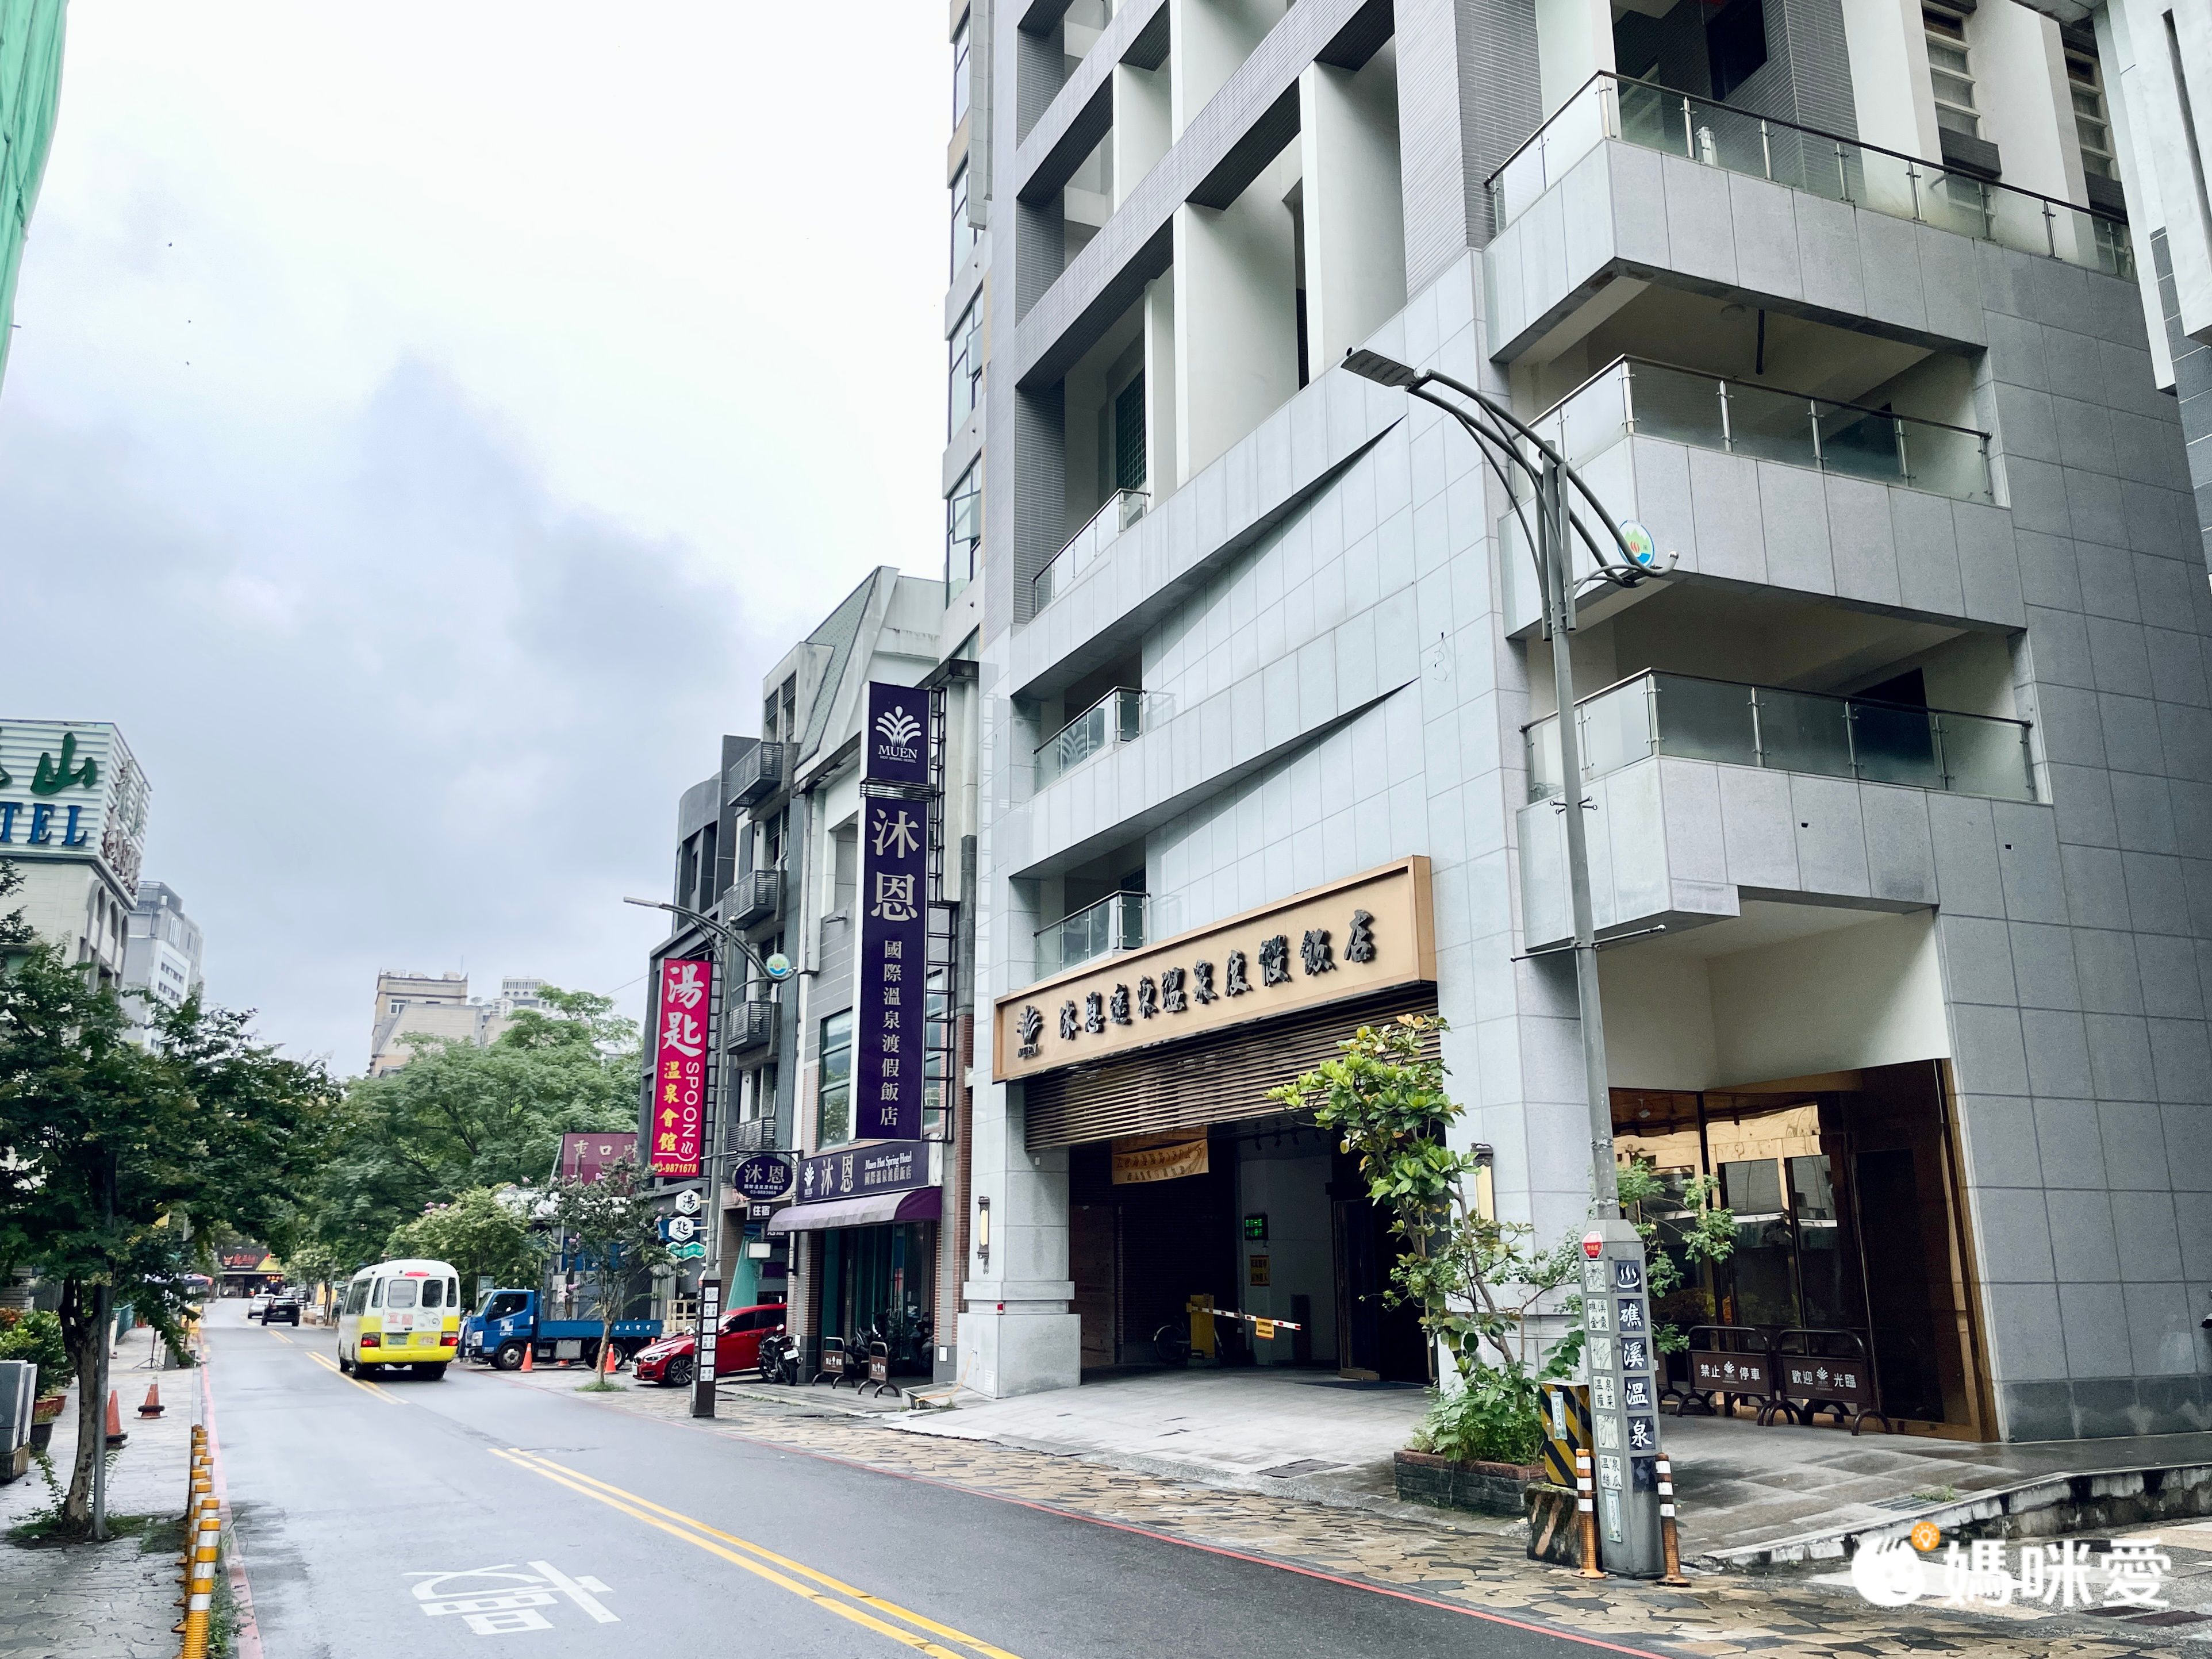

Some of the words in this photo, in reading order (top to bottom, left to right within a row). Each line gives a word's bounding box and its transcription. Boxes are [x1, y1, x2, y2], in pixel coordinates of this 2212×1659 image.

[877, 744, 918, 759] MUEN
[870, 809, 920, 922] 沐恩
[662, 963, 704, 1057] 湯匙
[880, 940, 903, 1127] 國際溫泉渡假飯店
[682, 1061, 700, 1138] SPOON
[877, 1157, 885, 1168] Hot
[885, 1154, 900, 1169] Spring
[900, 1150, 912, 1163] Hotel
[744, 1163, 785, 1184] 沐恩
[821, 1153, 854, 1196] 沐恩
[683, 1194, 696, 1209] 湯
[752, 1205, 771, 1216] 住宿
[675, 1220, 689, 1235] 匙
[1619, 1303, 1653, 1447] 礁溪溫泉
[1700, 1364, 1721, 1378] 禁止
[1739, 1366, 1761, 1381] 停車
[1791, 1370, 1814, 1385] 歡迎
[1833, 1372, 1857, 1388] 光臨
